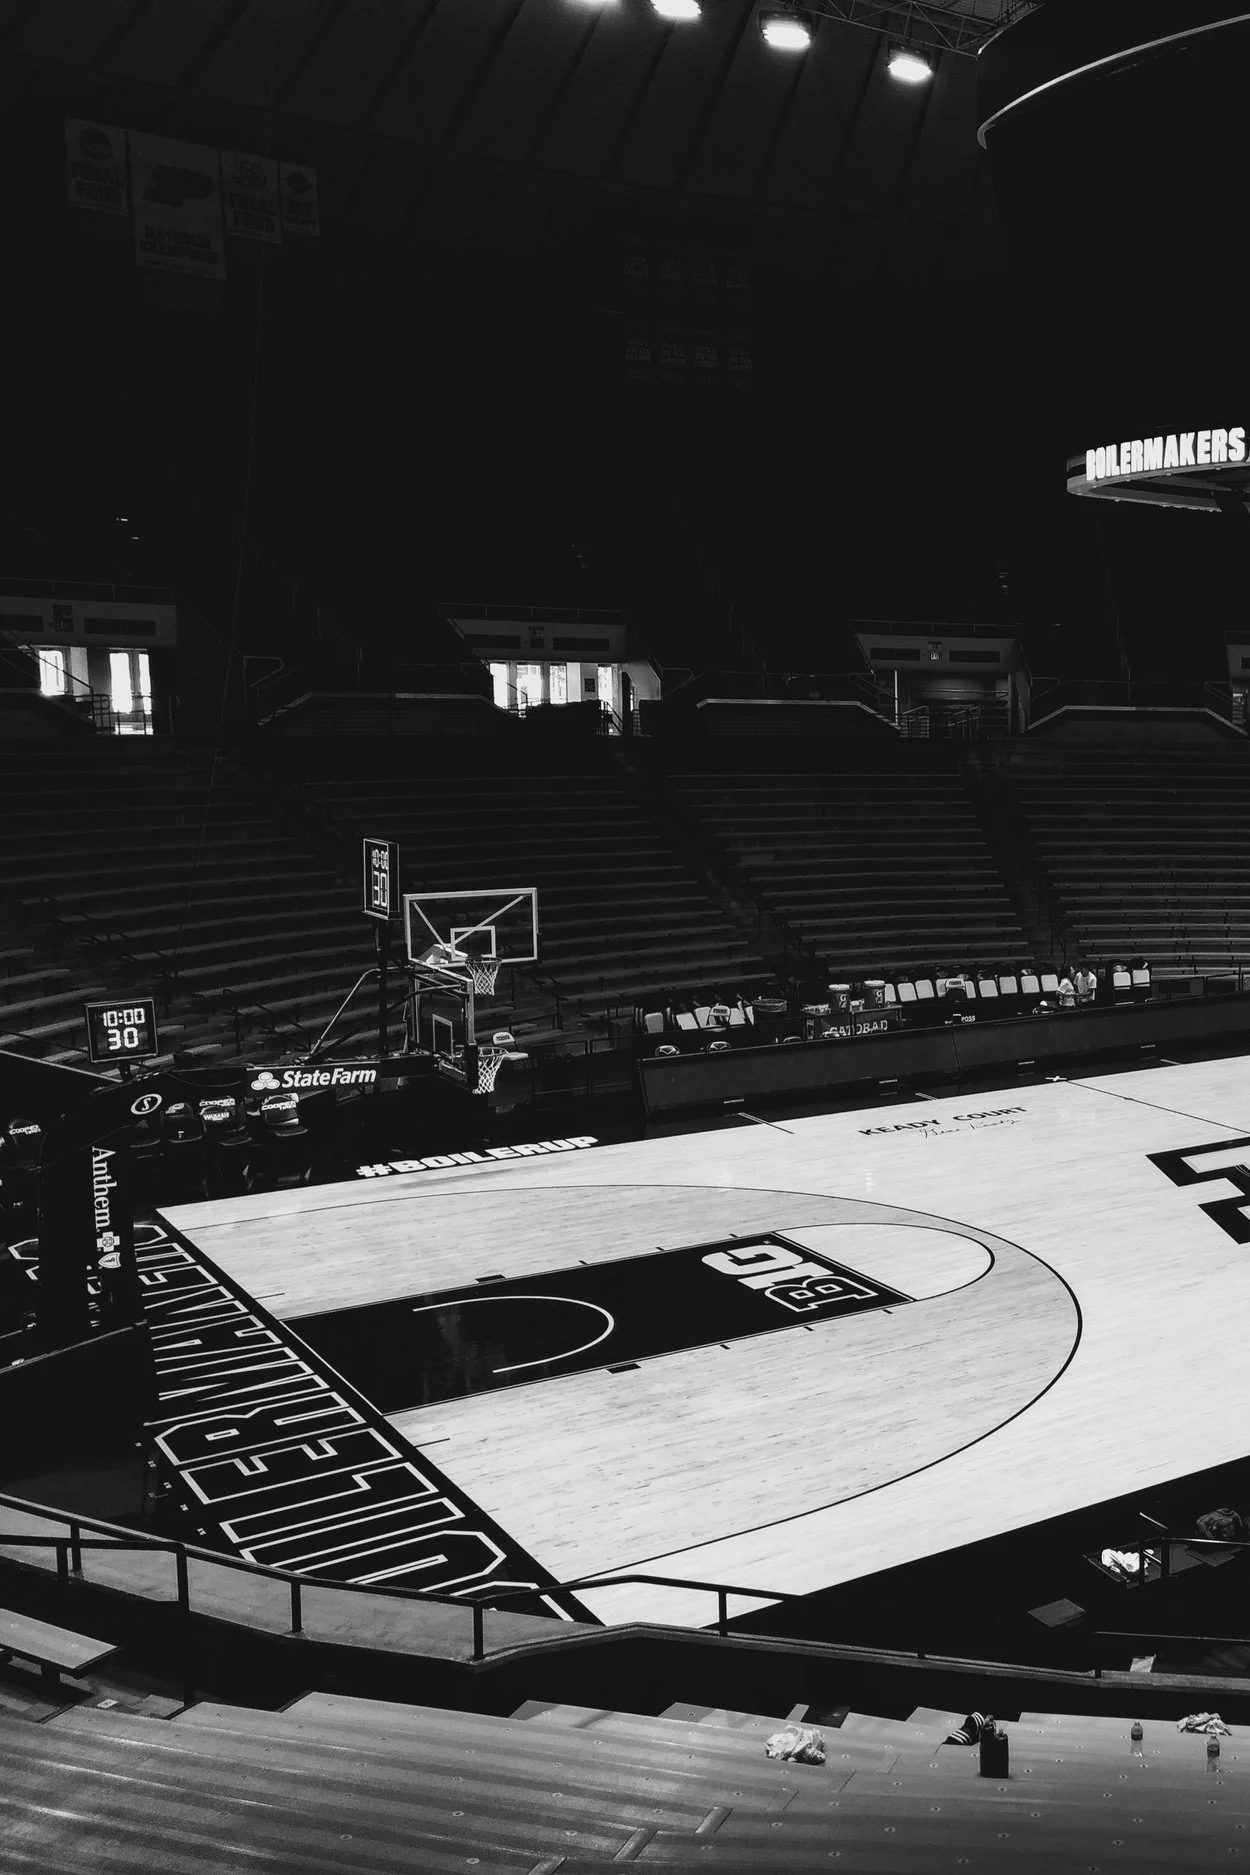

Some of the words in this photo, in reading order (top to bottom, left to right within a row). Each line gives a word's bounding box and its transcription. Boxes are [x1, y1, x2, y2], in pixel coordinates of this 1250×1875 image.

[1085, 427, 1247, 481] BOILERMAKERS
[372, 871, 388, 907] 30
[102, 1008, 146, 1028] 10:00
[107, 1027, 139, 1051] 30
[858, 1118, 941, 1136] KEADY
[952, 1106, 1028, 1122] COURT
[355, 1135, 599, 1178] #BOILERUP
[91, 1146, 118, 1230] Anthem
